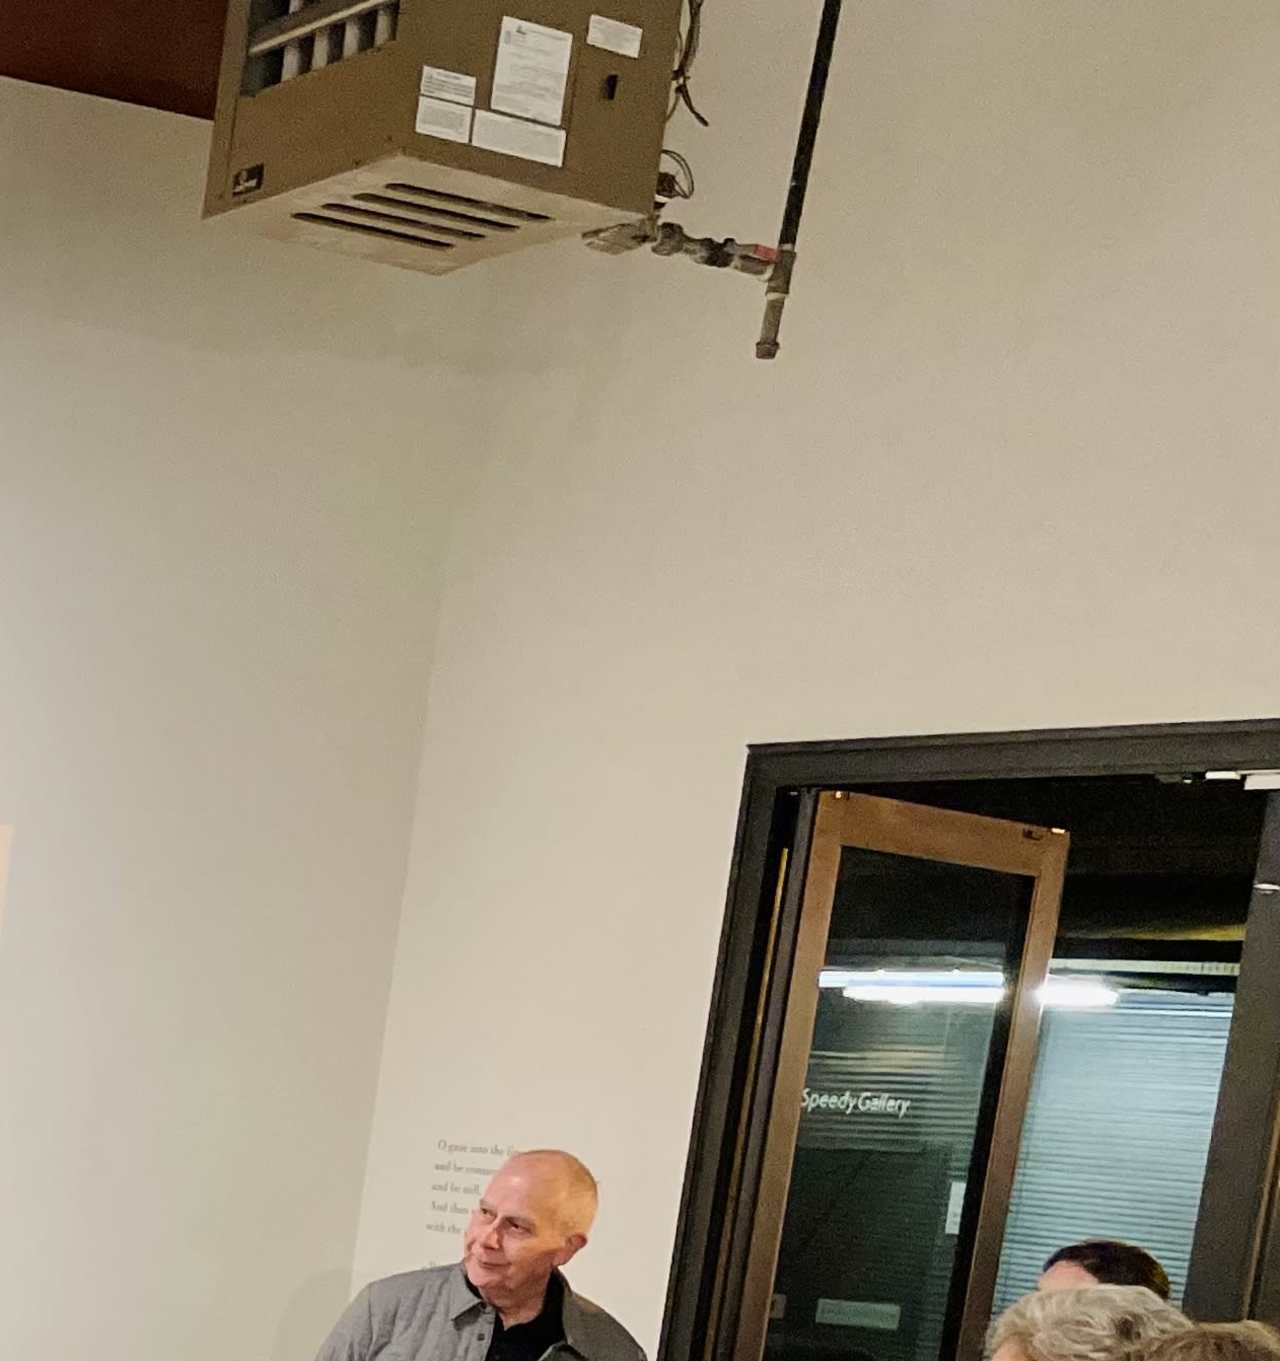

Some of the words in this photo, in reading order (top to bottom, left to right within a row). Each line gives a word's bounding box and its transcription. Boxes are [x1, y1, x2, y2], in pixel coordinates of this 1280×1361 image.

[490, 1143, 504, 1155] the
[434, 1160, 452, 1172] and
[431, 1180, 448, 1192] and
